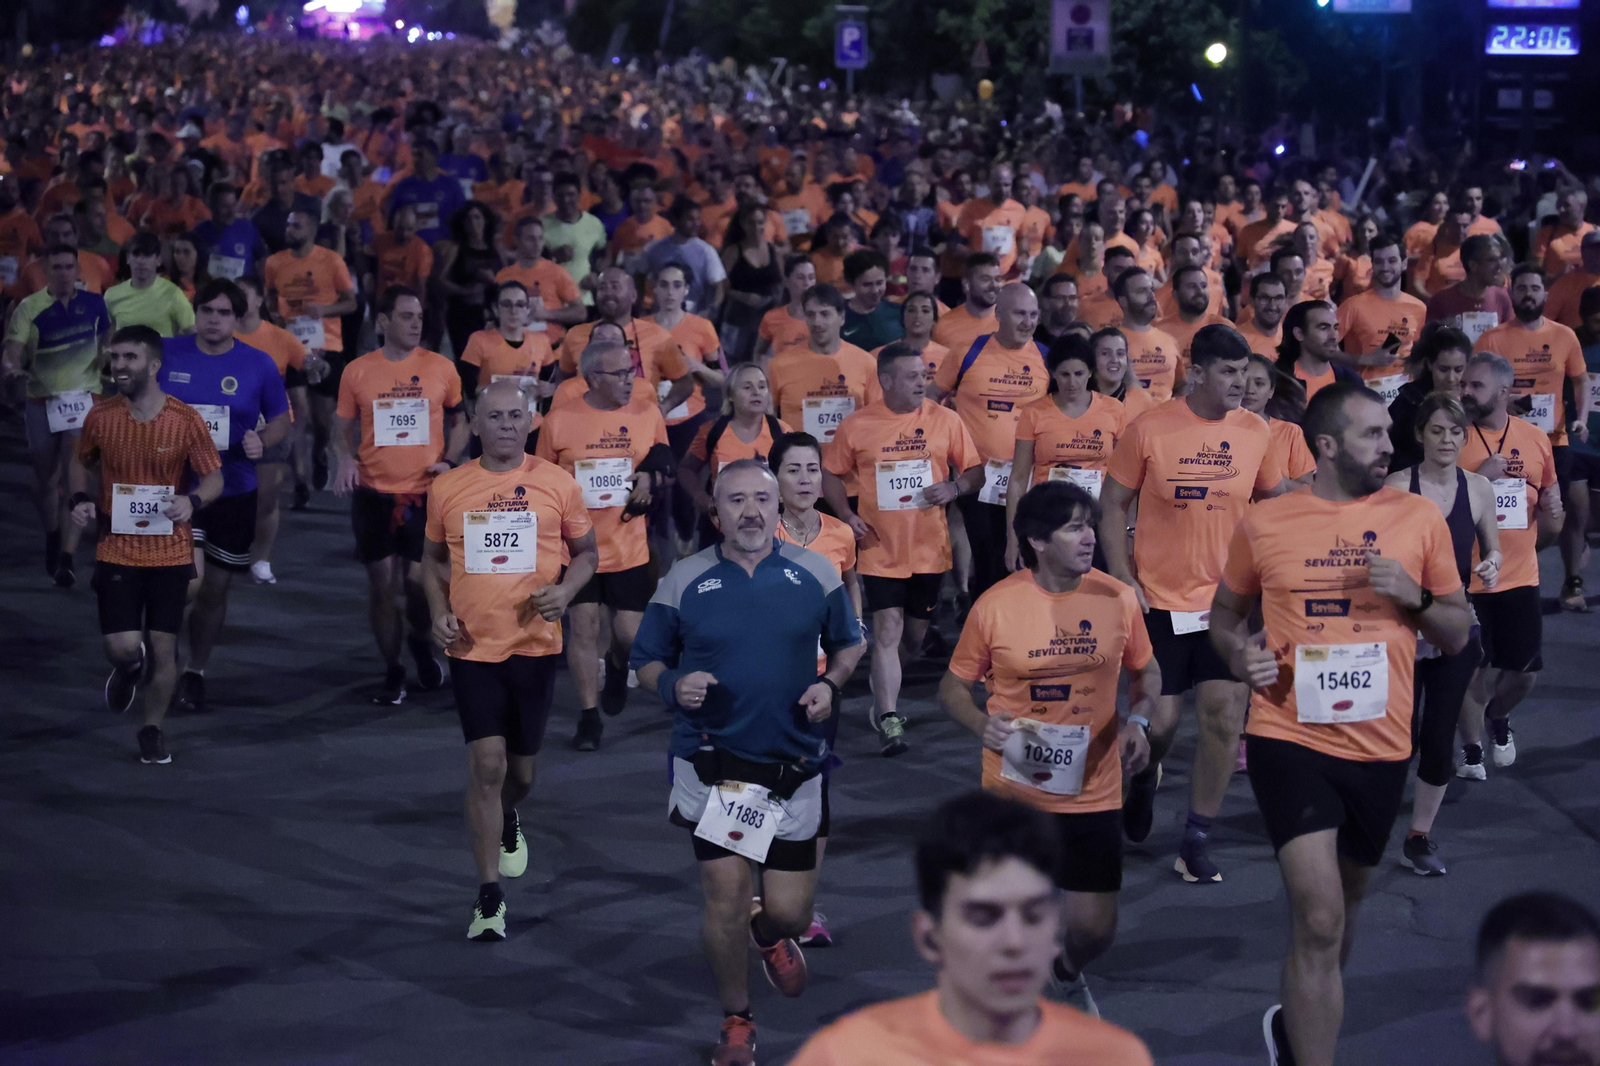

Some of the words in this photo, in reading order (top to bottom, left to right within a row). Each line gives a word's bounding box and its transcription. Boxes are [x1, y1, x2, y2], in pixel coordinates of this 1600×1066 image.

[843, 27, 859, 47] P
[1492, 26, 1571, 50] 22:06
[58, 402, 85, 414] 17183
[390, 415, 416, 426] 7695
[818, 413, 842, 424] 6749
[589, 475, 622, 488] 10806
[889, 476, 922, 490] 13702
[130, 502, 158, 514] 8334
[1496, 496, 1517, 508] 928
[484, 533, 518, 548] 5872
[1304, 559, 1350, 567] SEVILLA
[1050, 638, 1098, 646] NOCTURNA
[1028, 648, 1071, 658] SEVILLA
[1317, 670, 1371, 690] 15462
[1024, 744, 1073, 765] 10268
[727, 801, 764, 828] 11883
